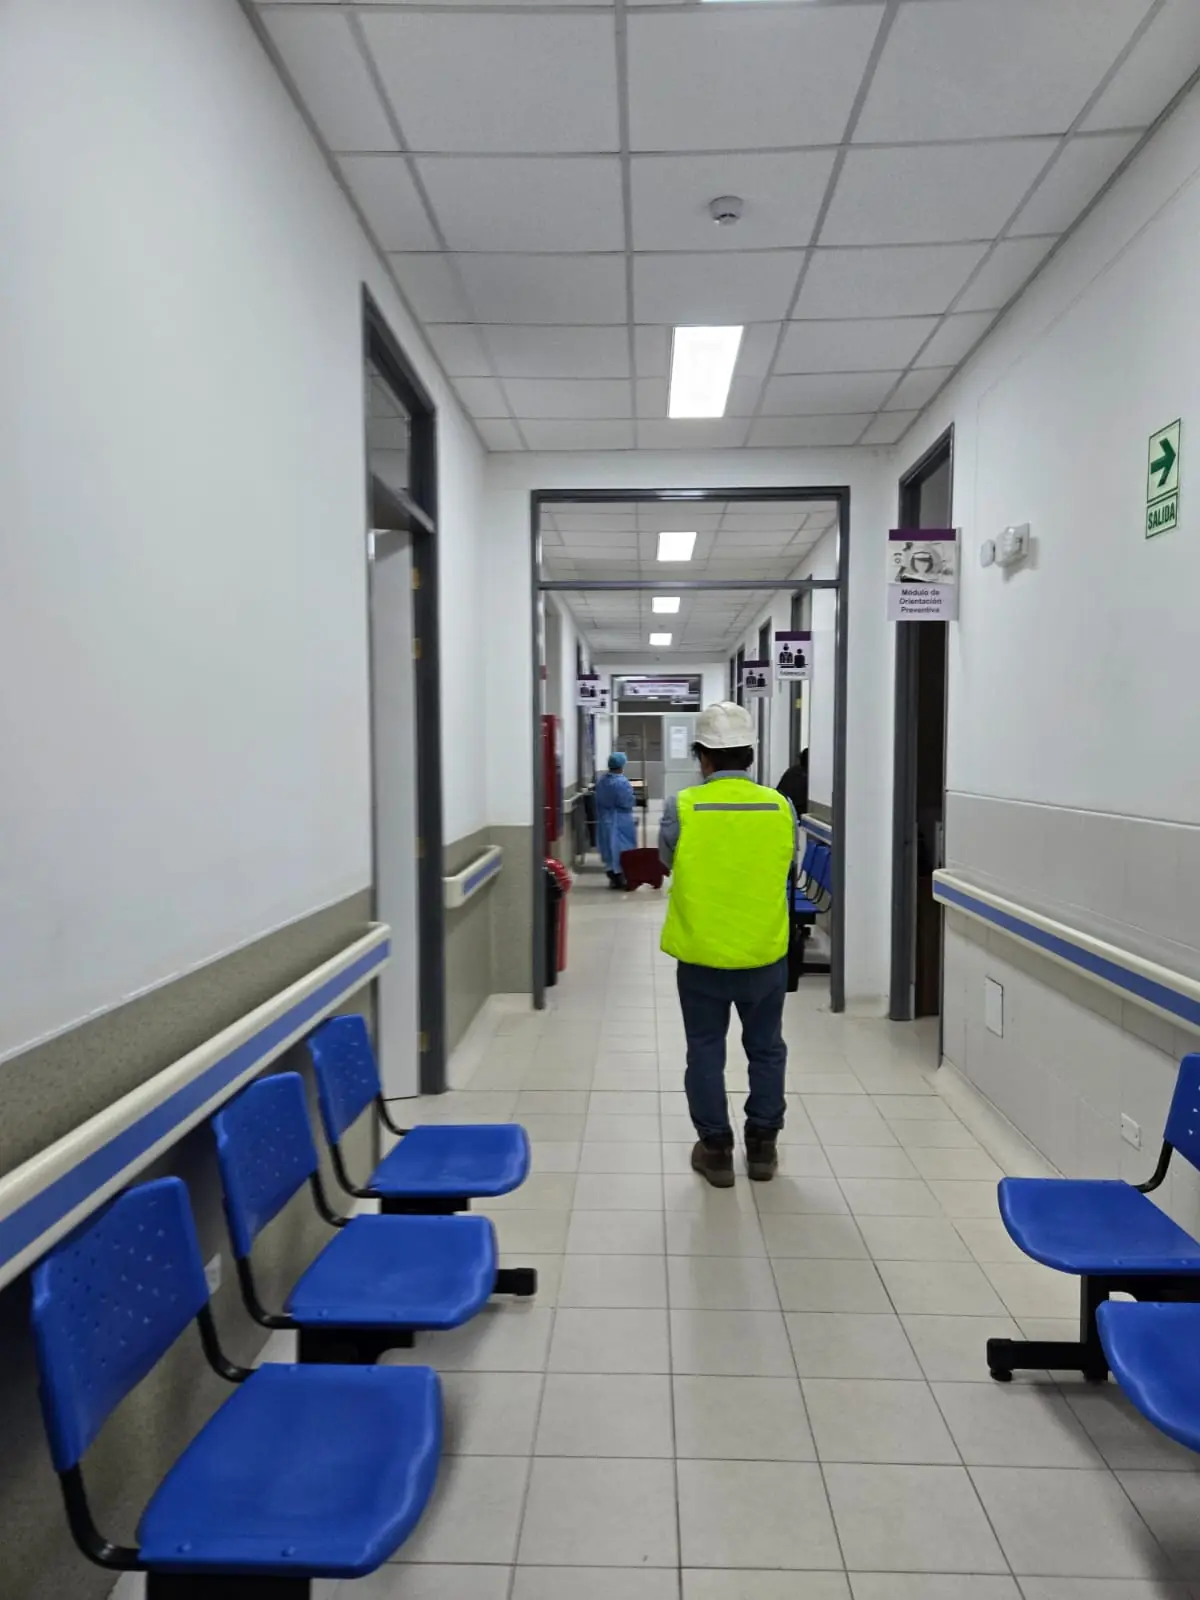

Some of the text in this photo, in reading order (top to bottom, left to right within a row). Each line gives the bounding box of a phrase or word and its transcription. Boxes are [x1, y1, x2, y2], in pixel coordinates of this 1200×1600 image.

[1148, 502, 1175, 530] SALIDA
[901, 588, 940, 596] Módulo de
[899, 597, 942, 605] Orientación
